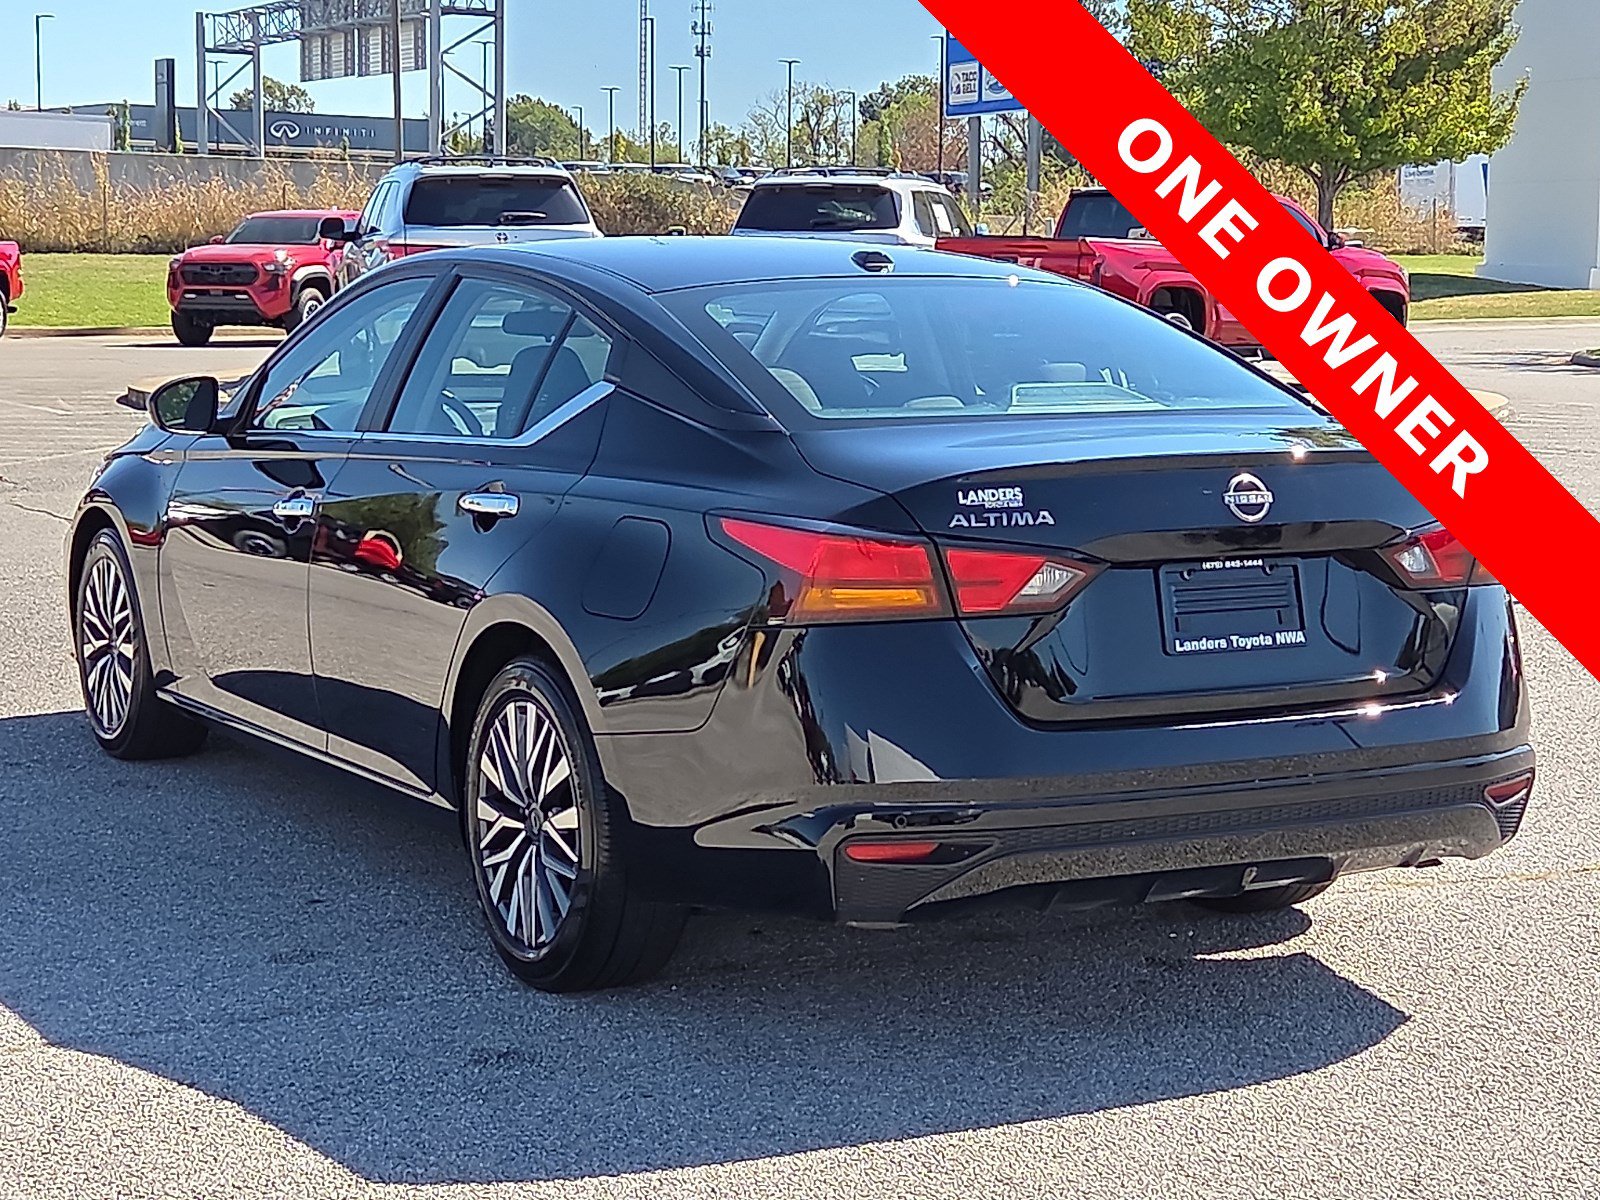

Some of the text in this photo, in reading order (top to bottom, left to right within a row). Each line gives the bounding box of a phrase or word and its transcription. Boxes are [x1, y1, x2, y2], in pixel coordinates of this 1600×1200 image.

[961, 71, 977, 82] TACO
[962, 83, 977, 94] BELL
[306, 125, 376, 138] INFINITI
[958, 487, 1023, 504] LANDERS
[1224, 492, 1274, 504] NISSAN
[949, 511, 1055, 528] ALTIMA
[1175, 631, 1306, 653] Landers Toyota NWA
